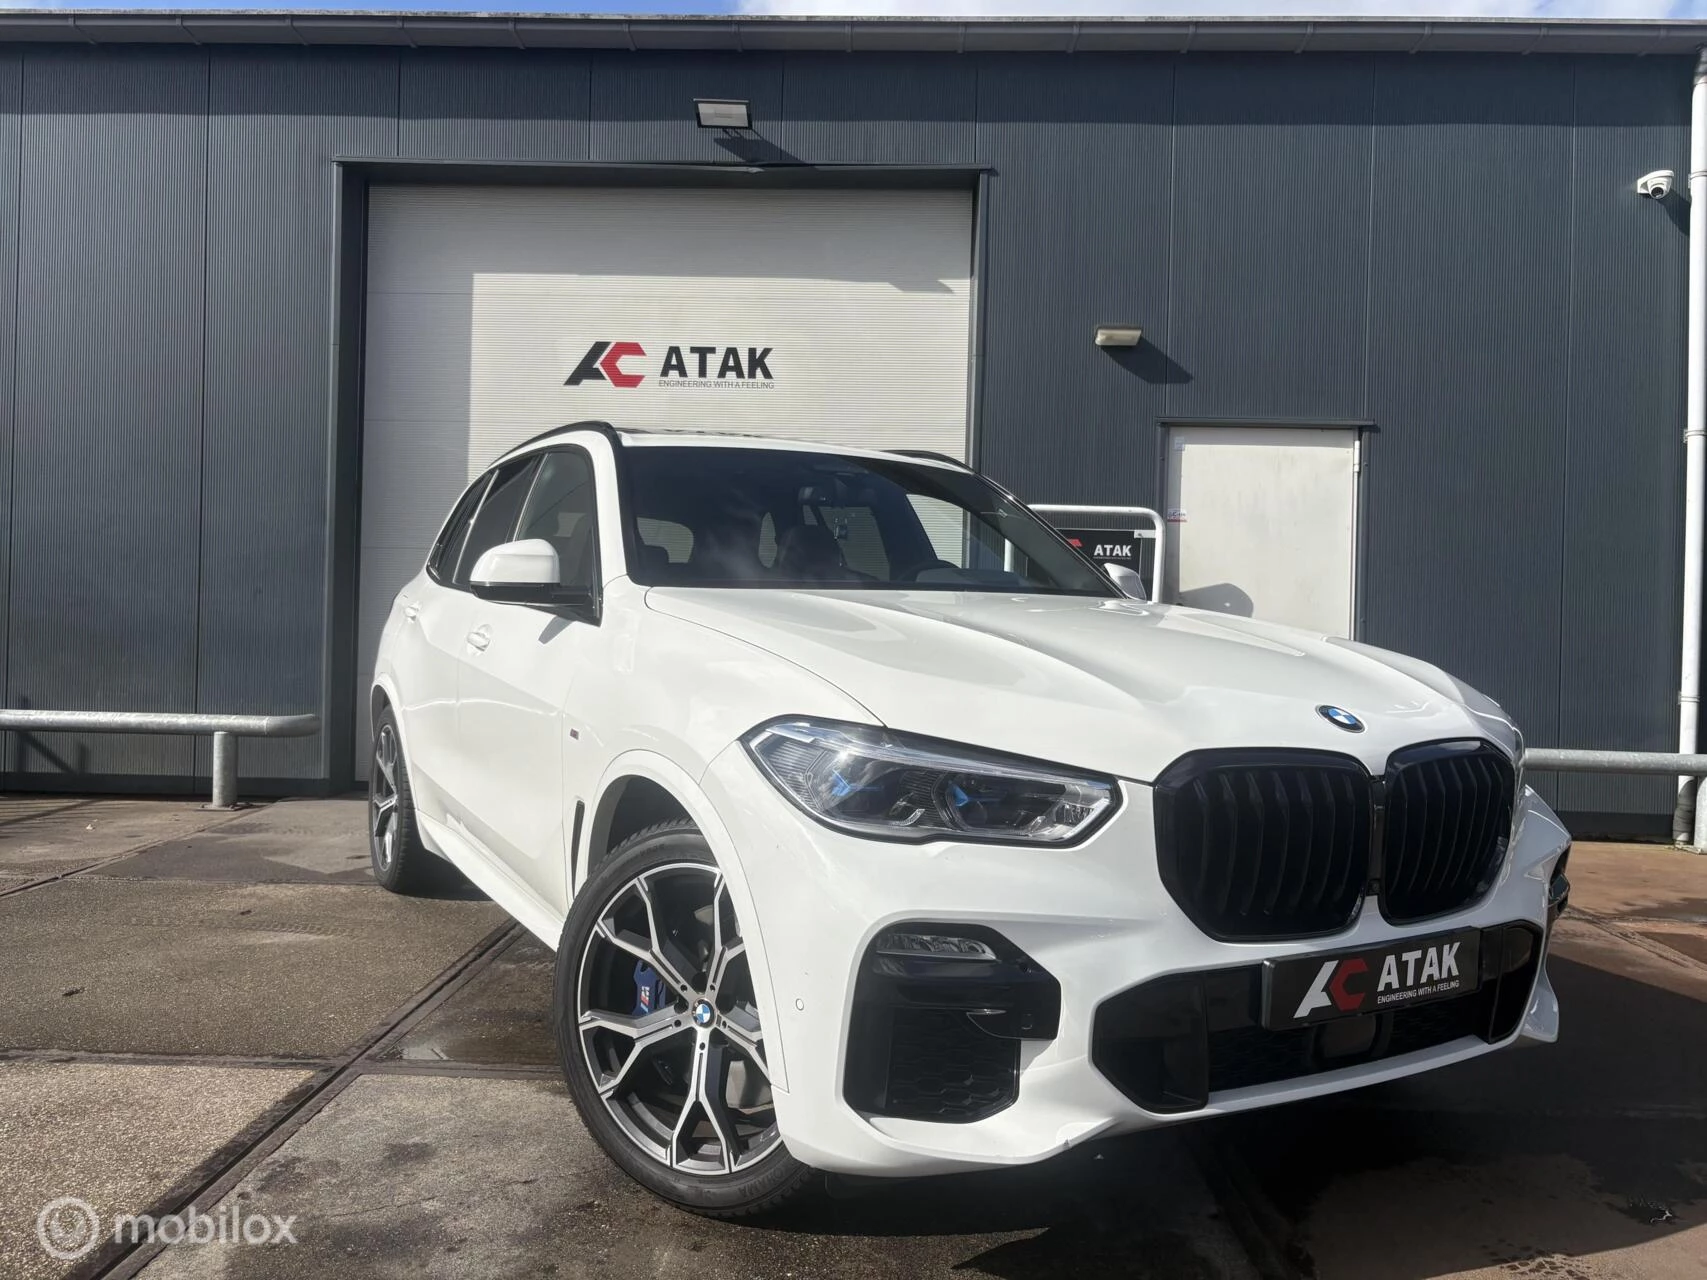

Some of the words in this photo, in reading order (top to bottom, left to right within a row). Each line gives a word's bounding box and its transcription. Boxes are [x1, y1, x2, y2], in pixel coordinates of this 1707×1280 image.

[660, 346, 774, 379] ATAK
[658, 379, 712, 388] ENGINEERING
[714, 381, 735, 389] WITH
[741, 381, 775, 390] FEELING
[1093, 544, 1132, 557] ATAK
[1377, 942, 1461, 992] ATAK
[1377, 989, 1417, 1004] ENGINEERING
[1417, 986, 1432, 997] WITH
[1437, 980, 1460, 991] FEELING
